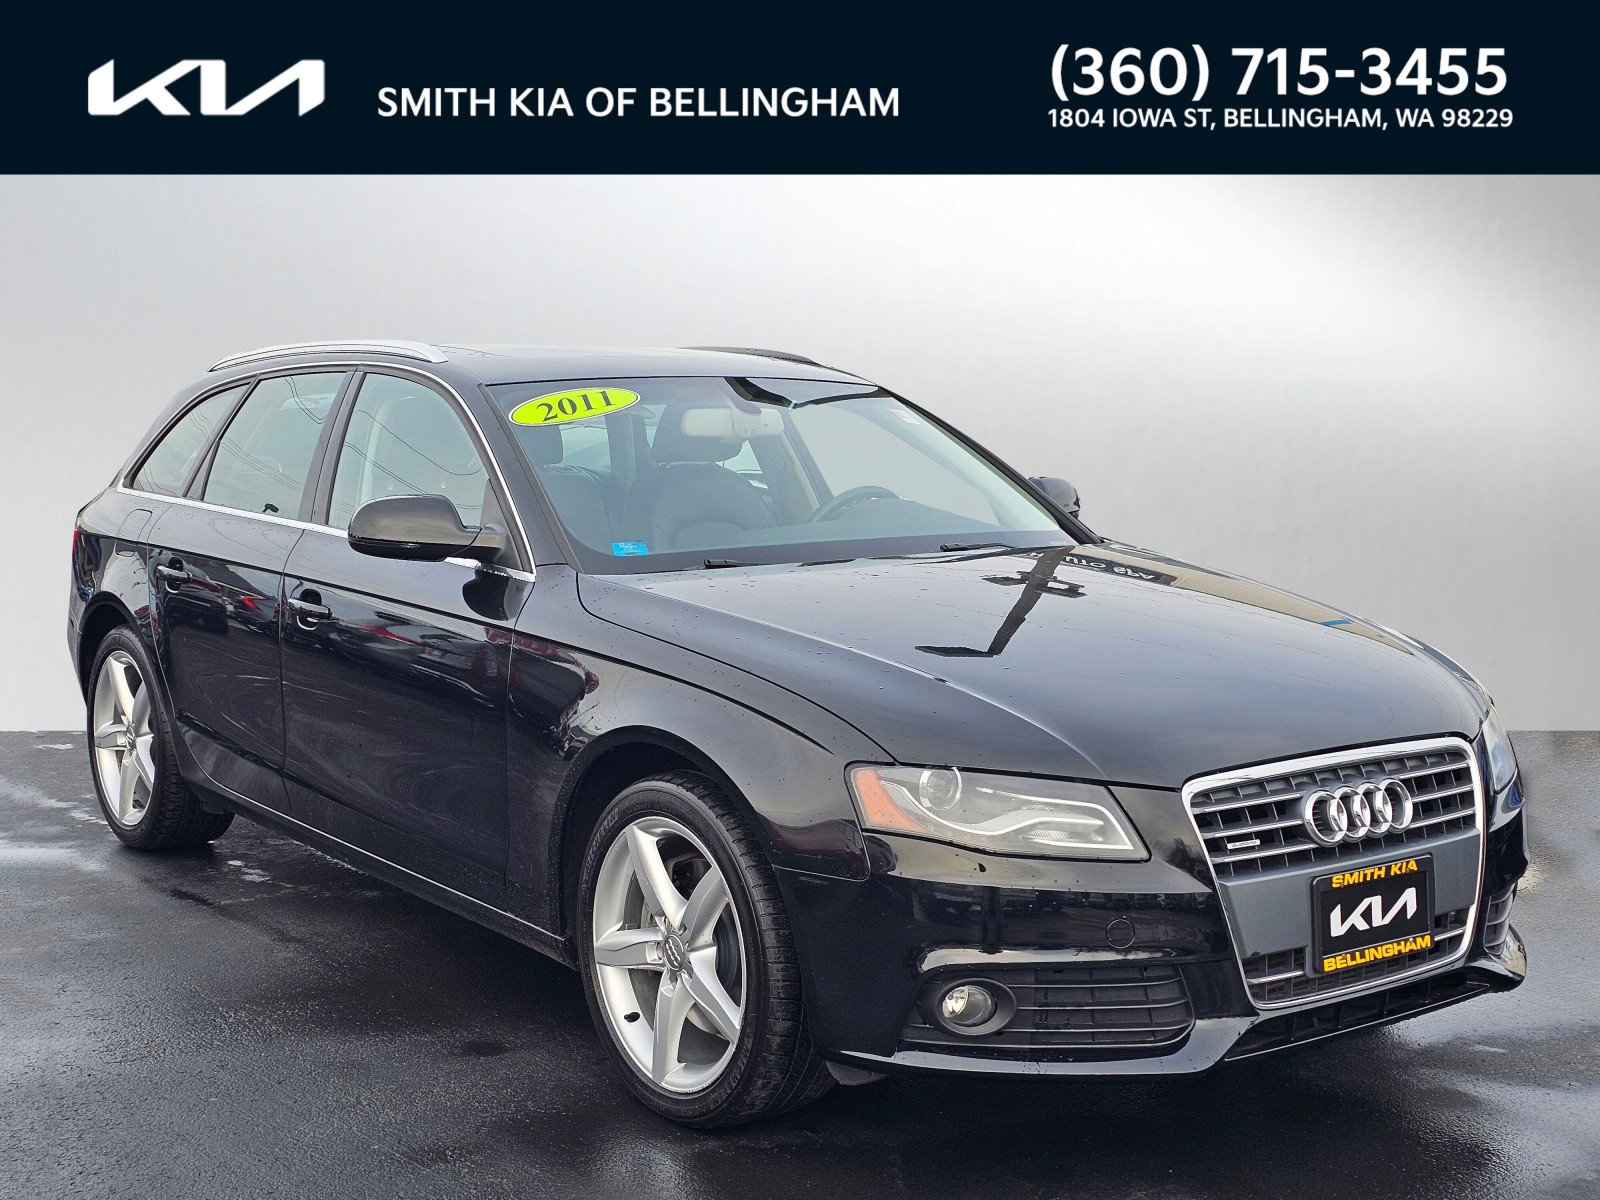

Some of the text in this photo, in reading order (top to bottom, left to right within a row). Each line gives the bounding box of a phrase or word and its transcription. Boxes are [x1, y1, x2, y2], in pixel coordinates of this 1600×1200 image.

[537, 391, 615, 421] 2011
[1332, 859, 1418, 889] SMITH KIA
[1330, 887, 1417, 937] KIA
[1323, 934, 1431, 972] BELLINGHAM
